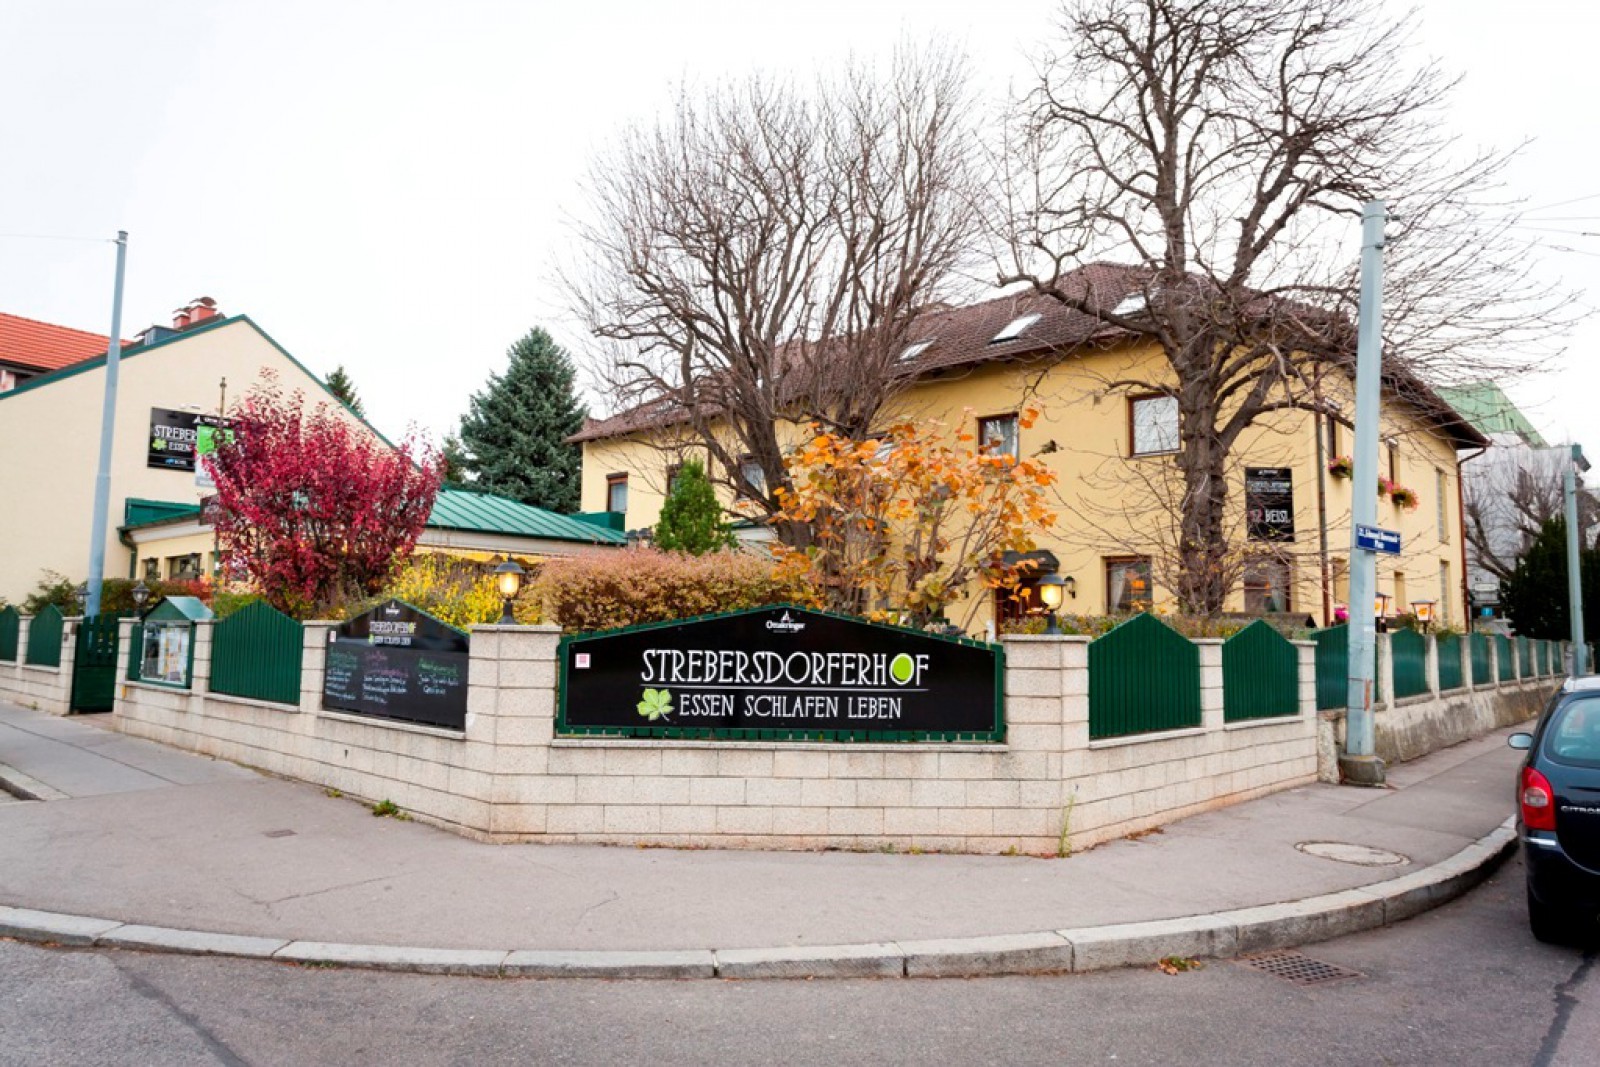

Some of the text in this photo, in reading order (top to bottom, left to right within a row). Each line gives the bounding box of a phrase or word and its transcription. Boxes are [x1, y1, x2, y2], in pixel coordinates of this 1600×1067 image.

[640, 649, 929, 686] STREBERSDORFERHOF
[679, 694, 902, 719] ESSEN SCHLAFEN LEBEN
